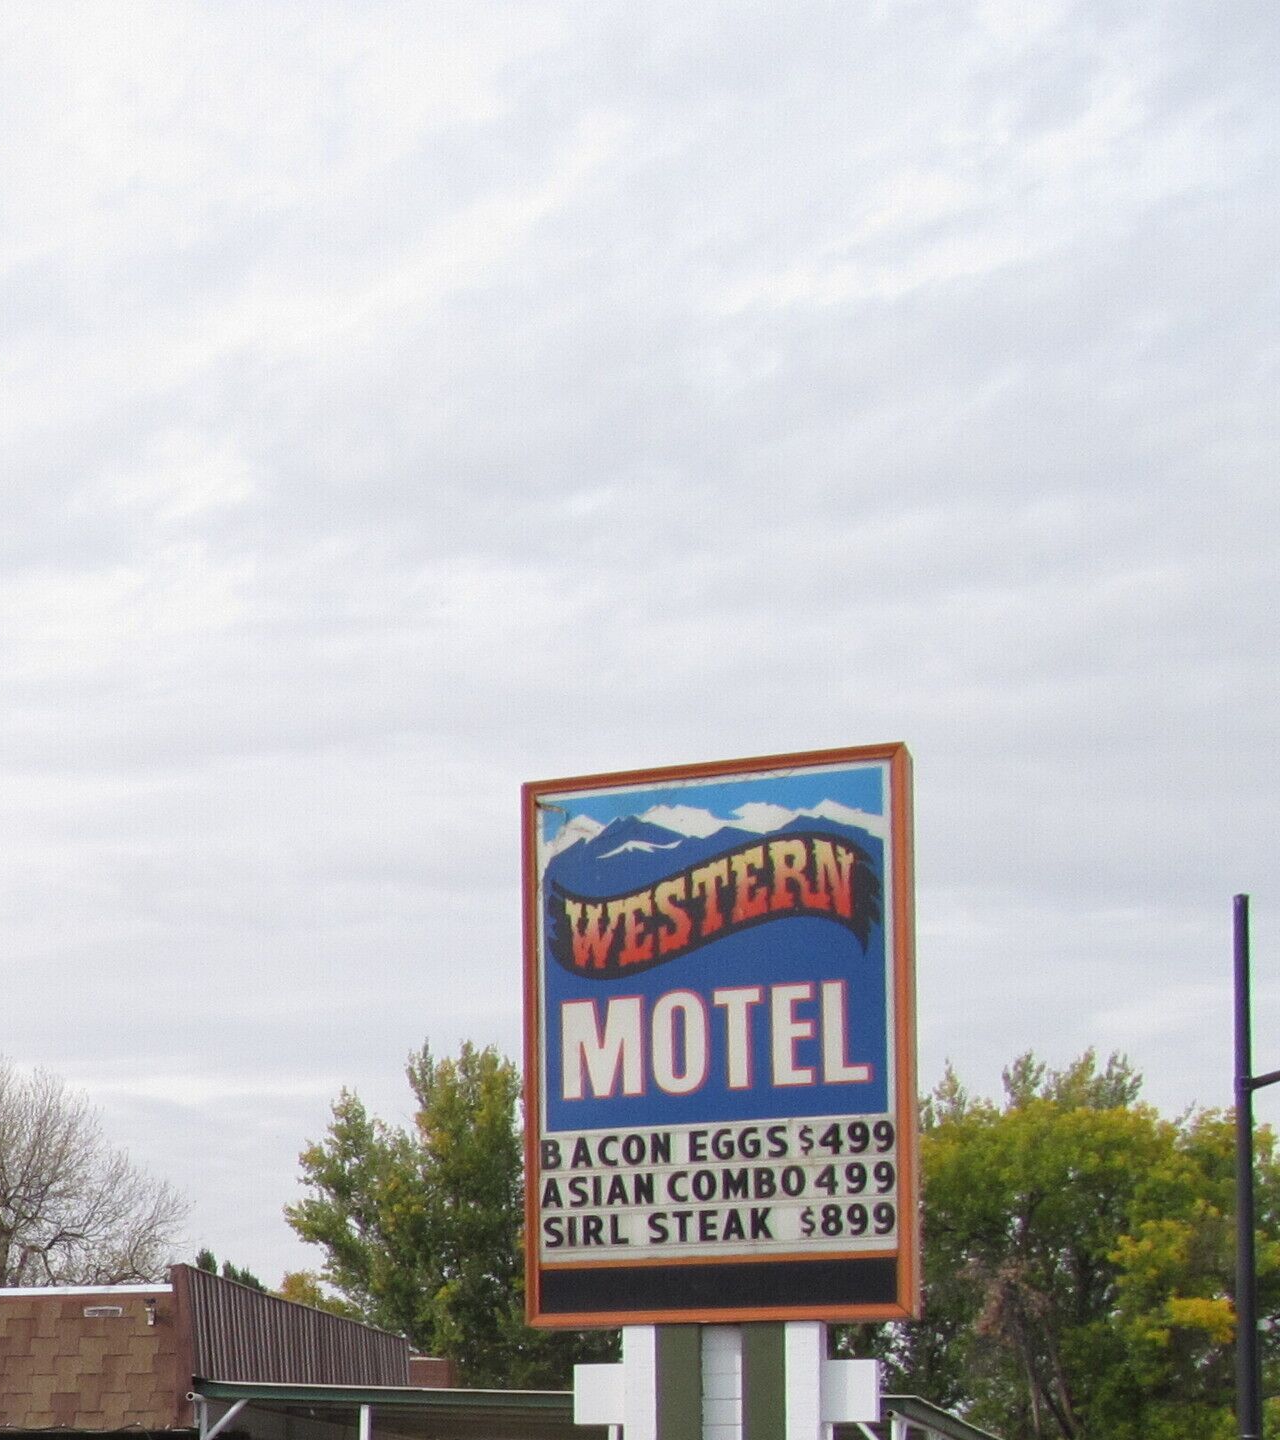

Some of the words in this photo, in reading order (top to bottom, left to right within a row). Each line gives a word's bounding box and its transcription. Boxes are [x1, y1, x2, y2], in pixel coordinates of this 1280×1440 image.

[564, 837, 854, 969] WESTERN
[560, 980, 872, 1100] MOTEL
[540, 1132, 671, 1170] BACON
[689, 1126, 788, 1162] EGGS
[798, 1120, 894, 1155] $499
[542, 1173, 653, 1208] ASIAN
[668, 1167, 805, 1201] COMBO
[815, 1161, 894, 1195] 499
[546, 1214, 629, 1248] SIRL
[648, 1207, 773, 1244] STEAK
[800, 1202, 895, 1237] $899
